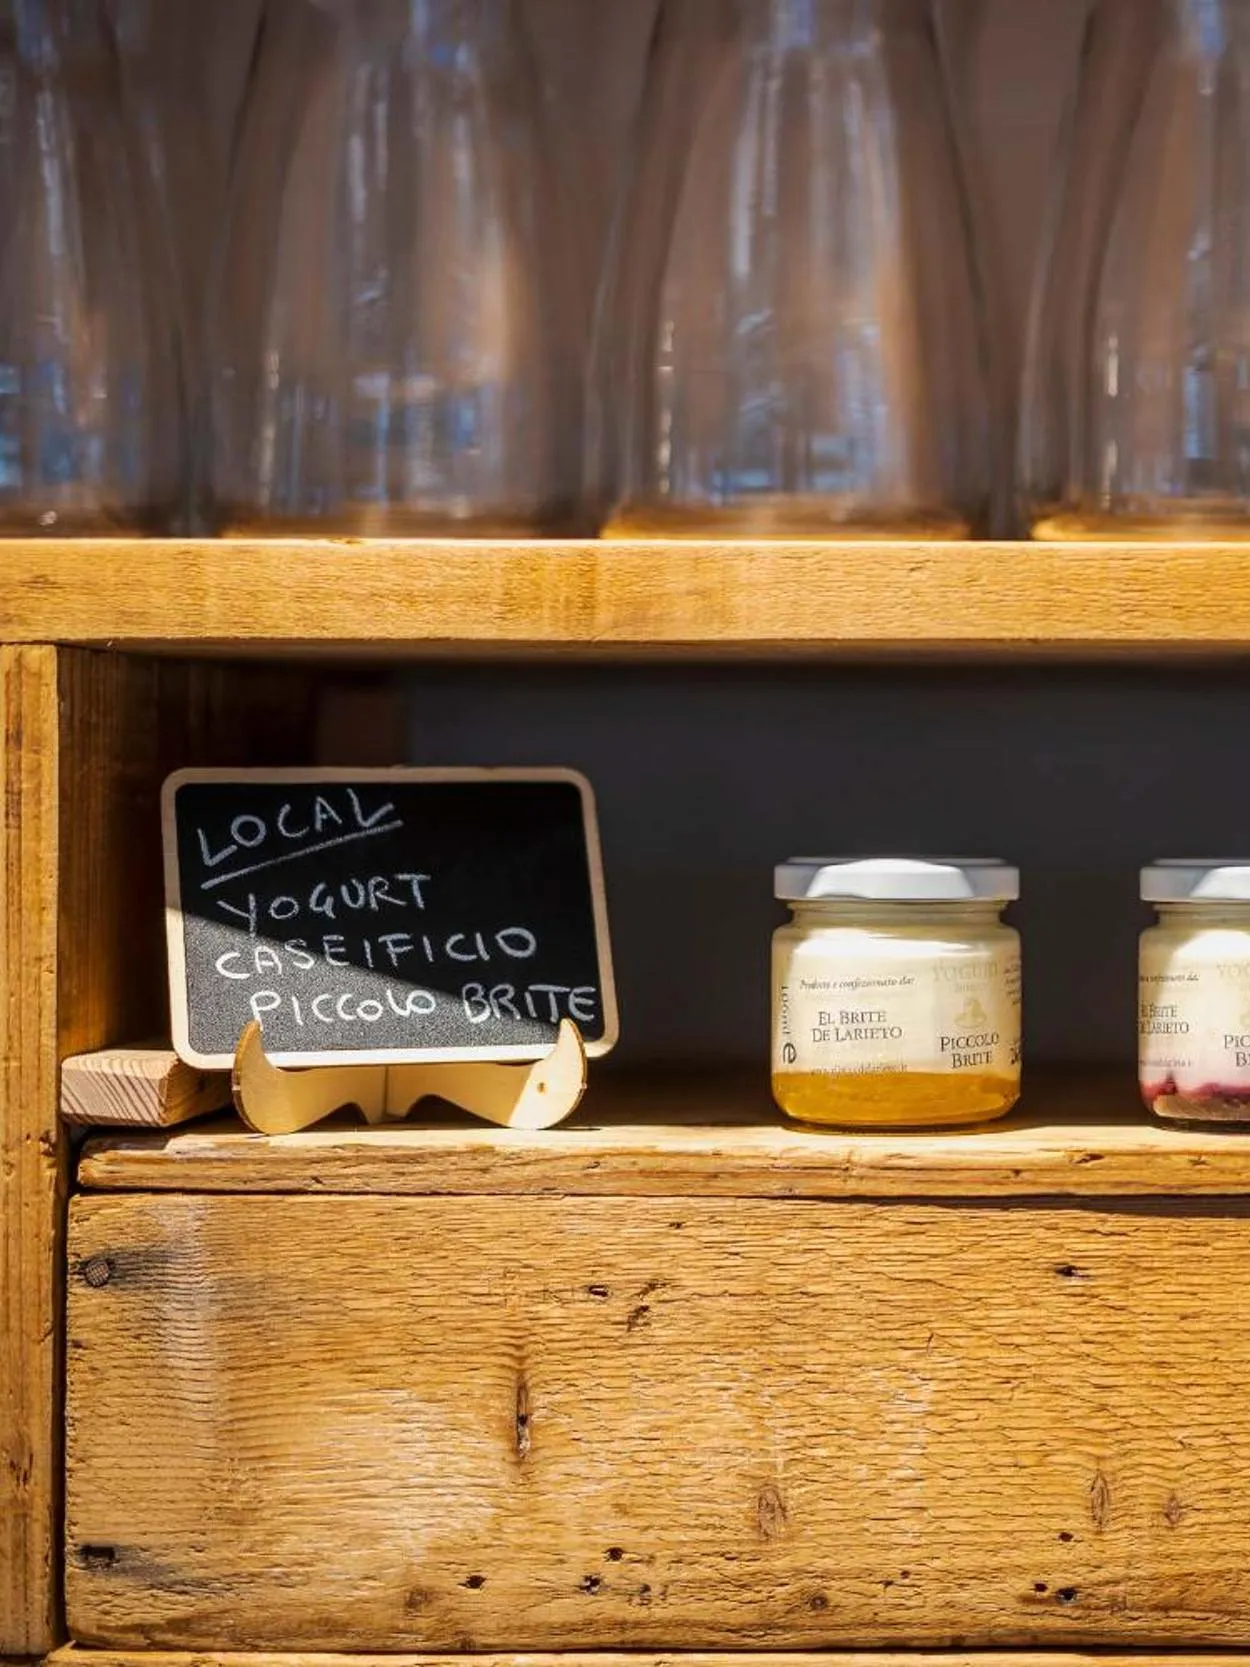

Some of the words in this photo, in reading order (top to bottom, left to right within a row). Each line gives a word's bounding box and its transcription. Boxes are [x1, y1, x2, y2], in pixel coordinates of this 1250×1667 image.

[197, 788, 395, 866] LOCAL
[217, 874, 431, 937] YOGURT
[215, 927, 537, 979] CASEIFICIO
[249, 989, 437, 1031] PICCOLO
[461, 982, 597, 1023] BRITE
[818, 1011, 835, 1026] EL
[840, 1010, 887, 1025] BRITE
[812, 1028, 831, 1043] DE
[835, 1026, 903, 1042] LARIETO
[939, 1032, 999, 1053] PICCOLO
[951, 1050, 993, 1069] BRITE
